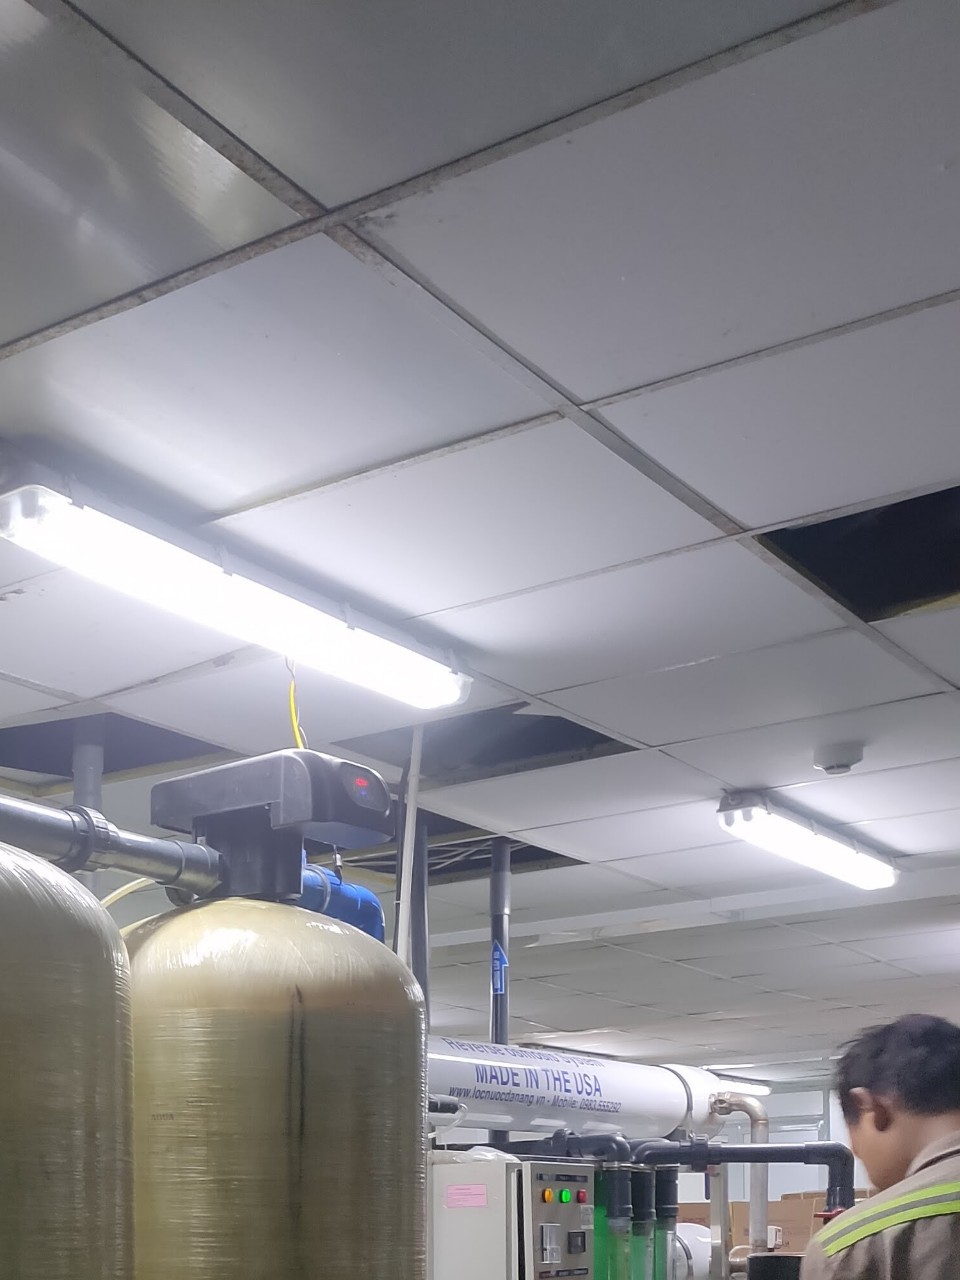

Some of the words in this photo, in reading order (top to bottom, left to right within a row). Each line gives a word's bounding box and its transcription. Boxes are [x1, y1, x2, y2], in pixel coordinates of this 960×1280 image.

[441, 1036, 505, 1056] Reverse
[476, 1065, 520, 1087] MADE
[523, 1067, 540, 1090] IN
[541, 1069, 572, 1094] THE
[572, 1072, 603, 1098] USA
